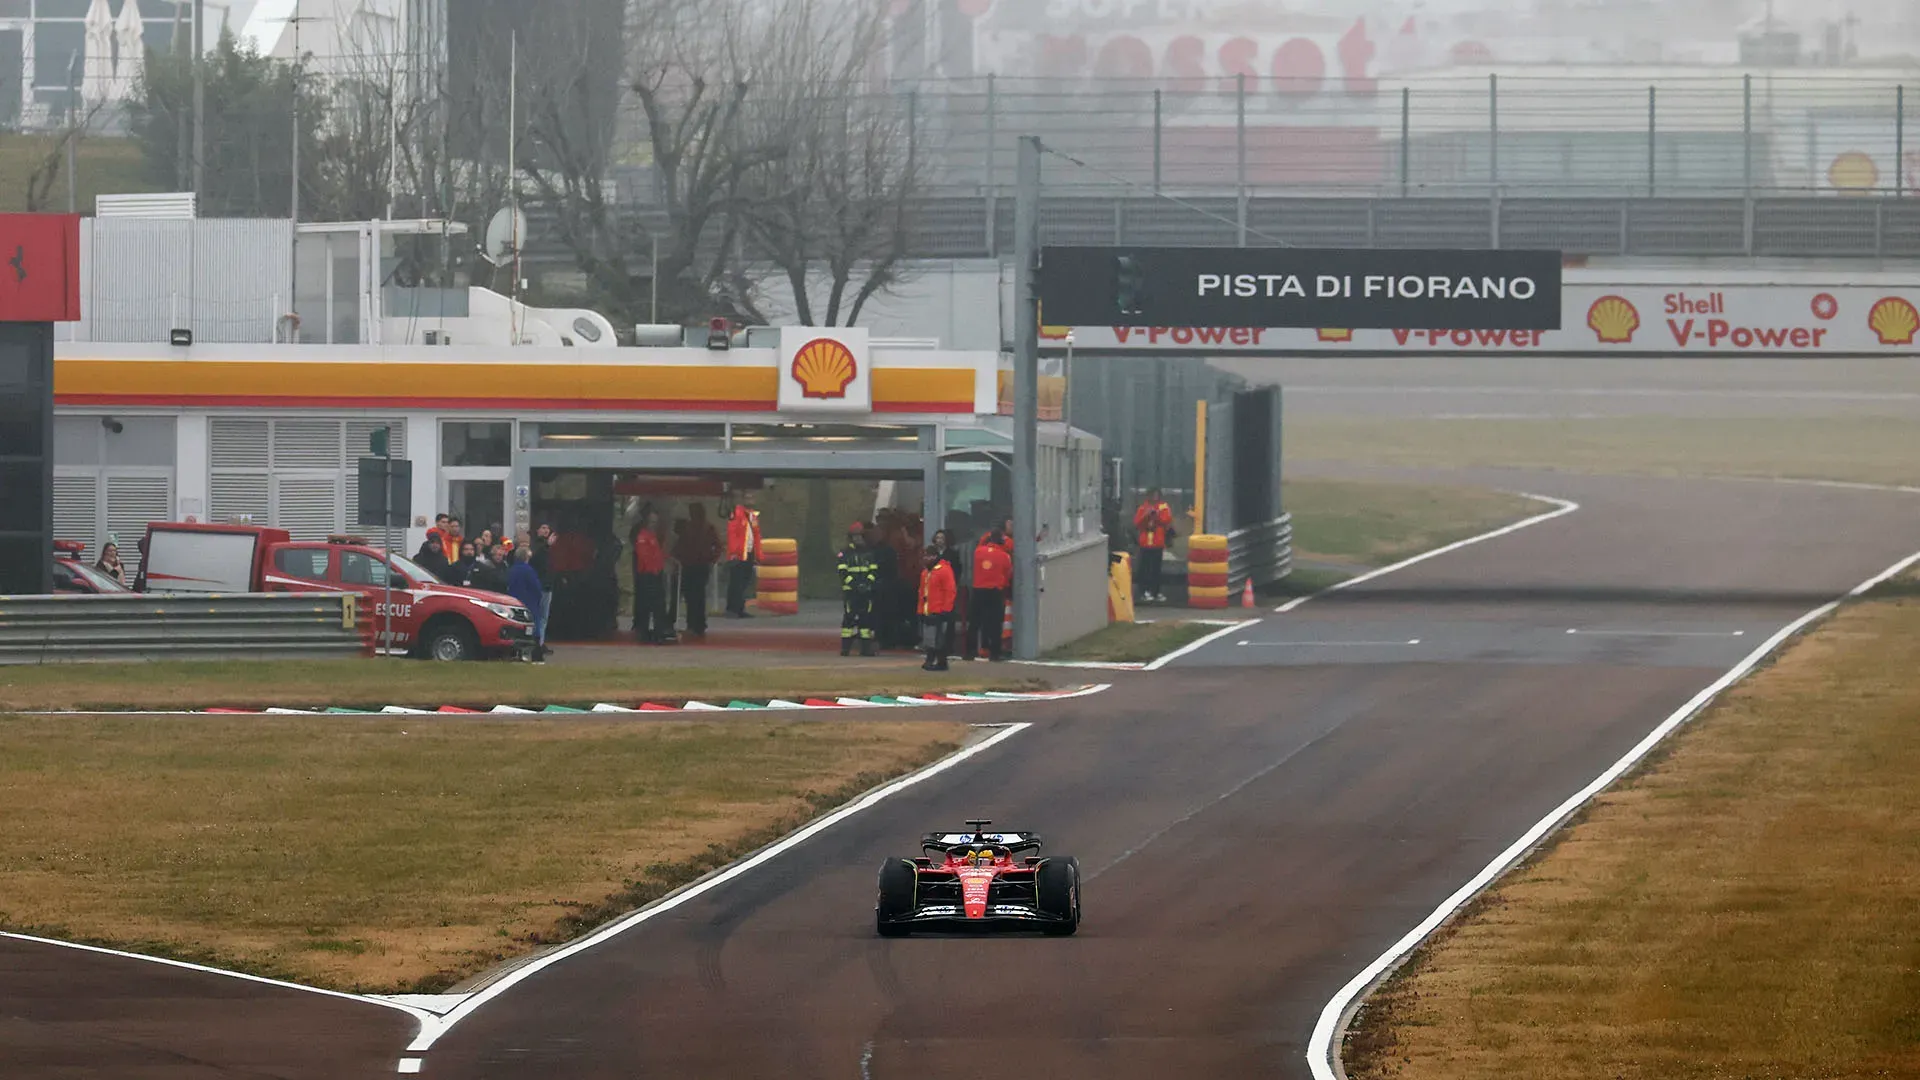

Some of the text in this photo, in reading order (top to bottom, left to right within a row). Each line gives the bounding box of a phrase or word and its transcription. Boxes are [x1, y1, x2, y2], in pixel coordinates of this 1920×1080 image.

[1198, 274, 1536, 300] PISTA DI FIORANO
[1663, 292, 1724, 314] Shell
[1667, 318, 1827, 348] V-Power
[346, 603, 352, 620] 1
